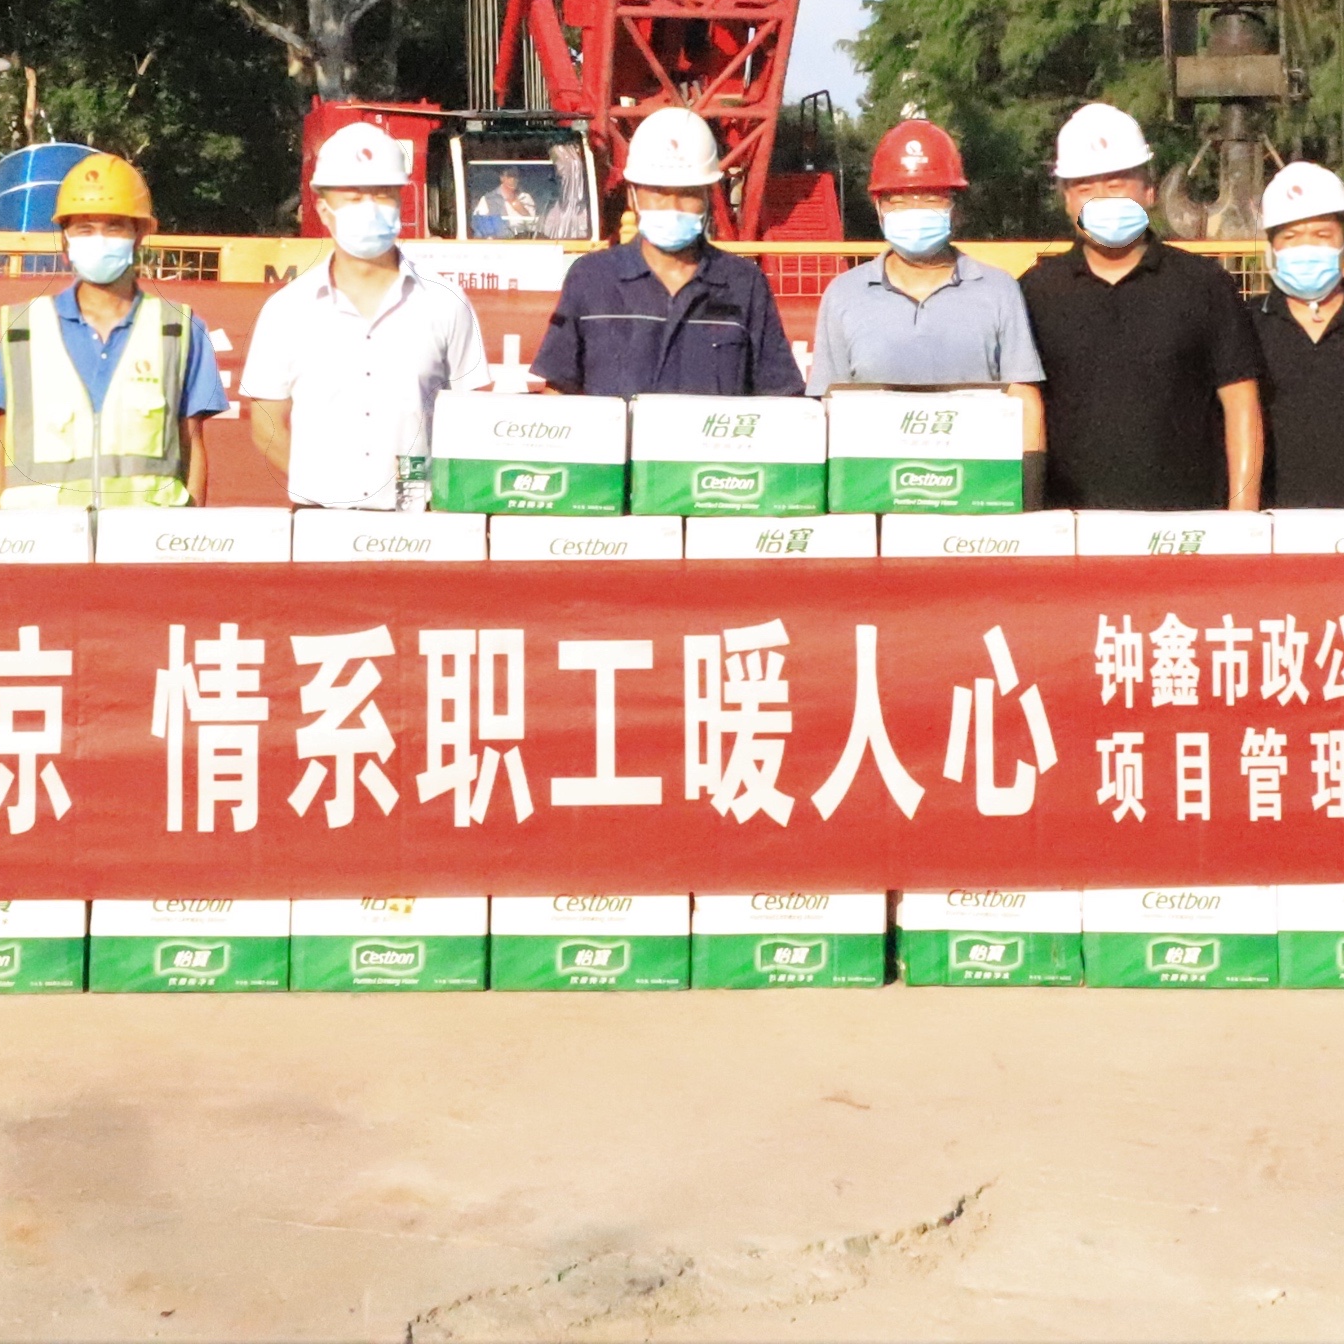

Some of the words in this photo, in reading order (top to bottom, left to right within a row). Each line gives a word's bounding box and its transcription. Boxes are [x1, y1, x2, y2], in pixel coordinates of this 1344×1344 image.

[152, 619, 1058, 832] 情系职工暖人心
